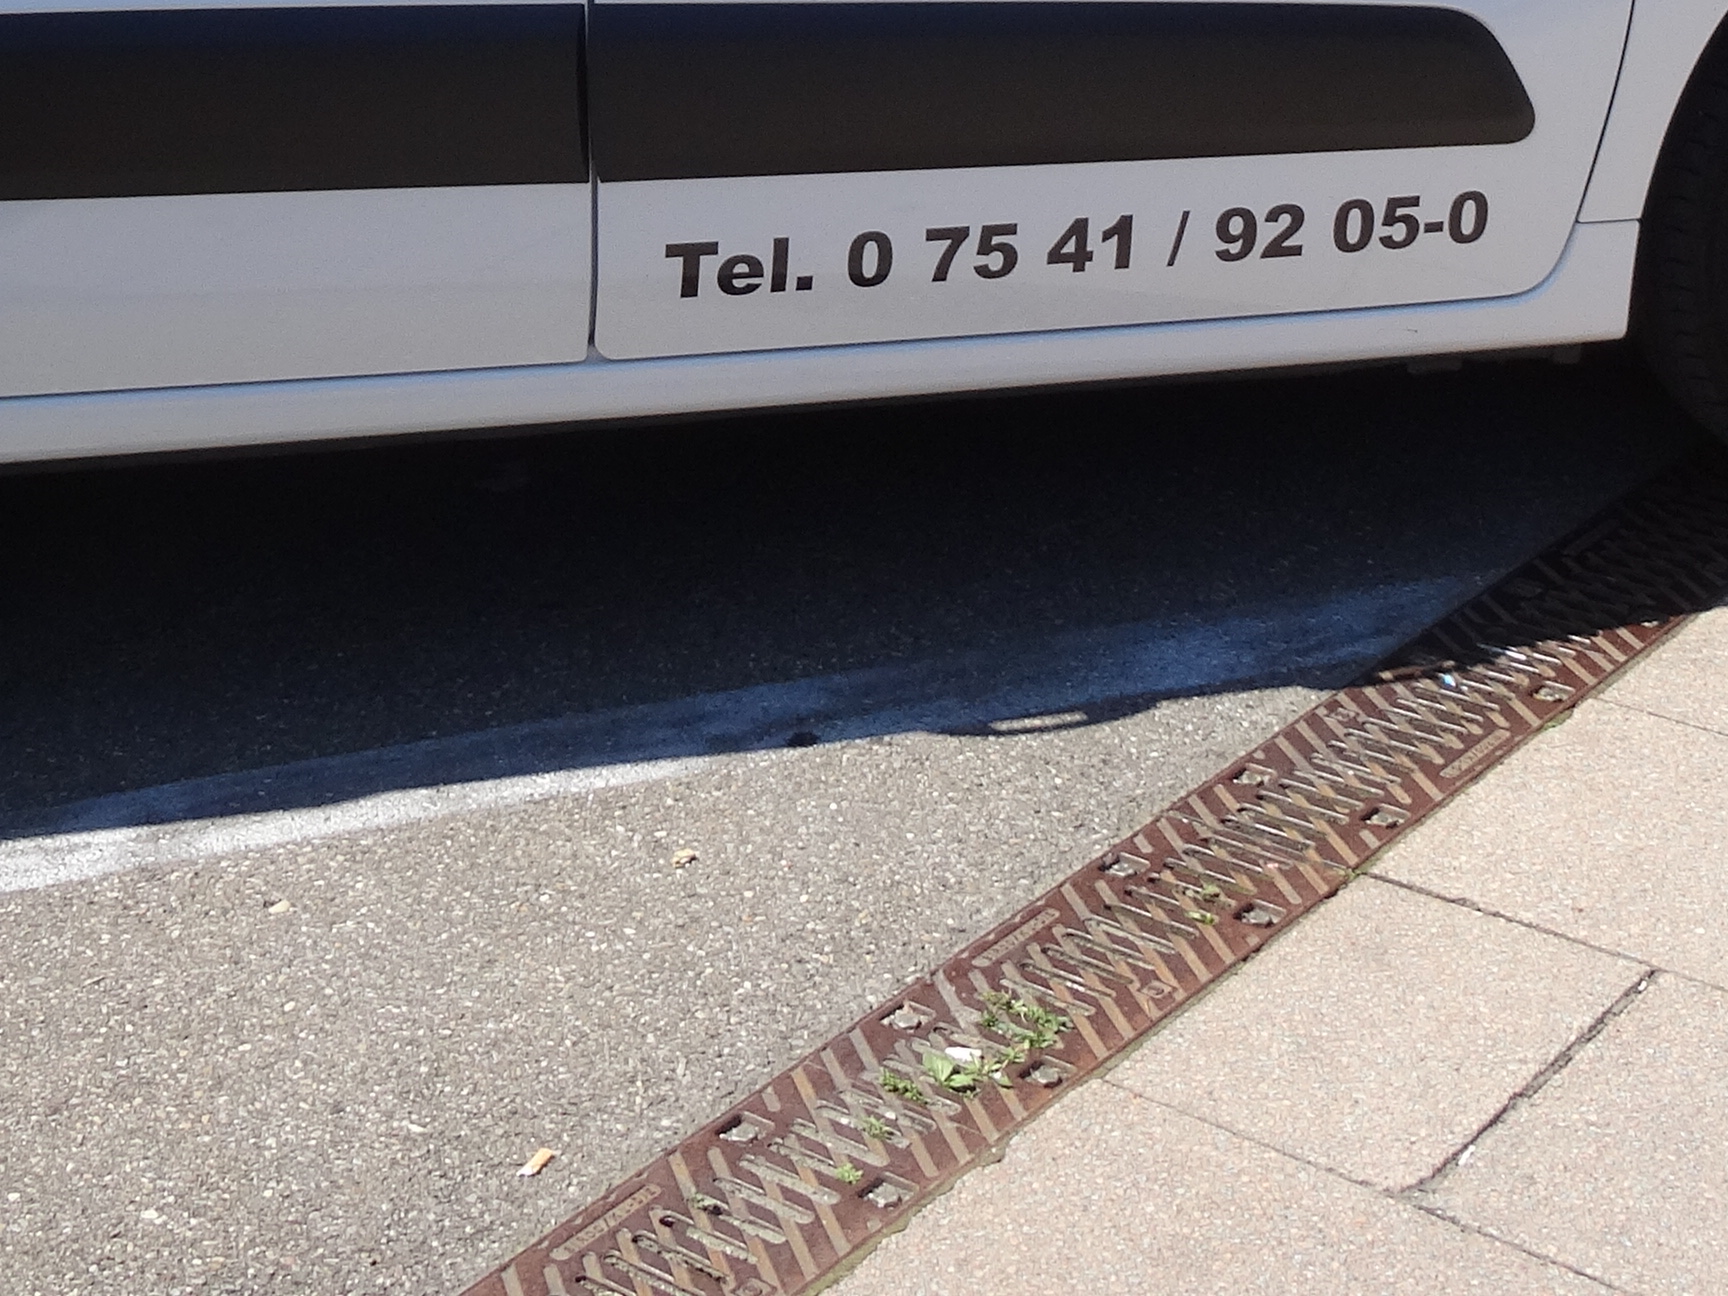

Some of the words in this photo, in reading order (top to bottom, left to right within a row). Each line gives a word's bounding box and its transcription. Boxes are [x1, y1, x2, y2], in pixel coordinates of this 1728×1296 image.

[665, 237, 815, 298] Tel.
[847, 230, 894, 288] 0
[1332, 189, 1489, 253] 05-0
